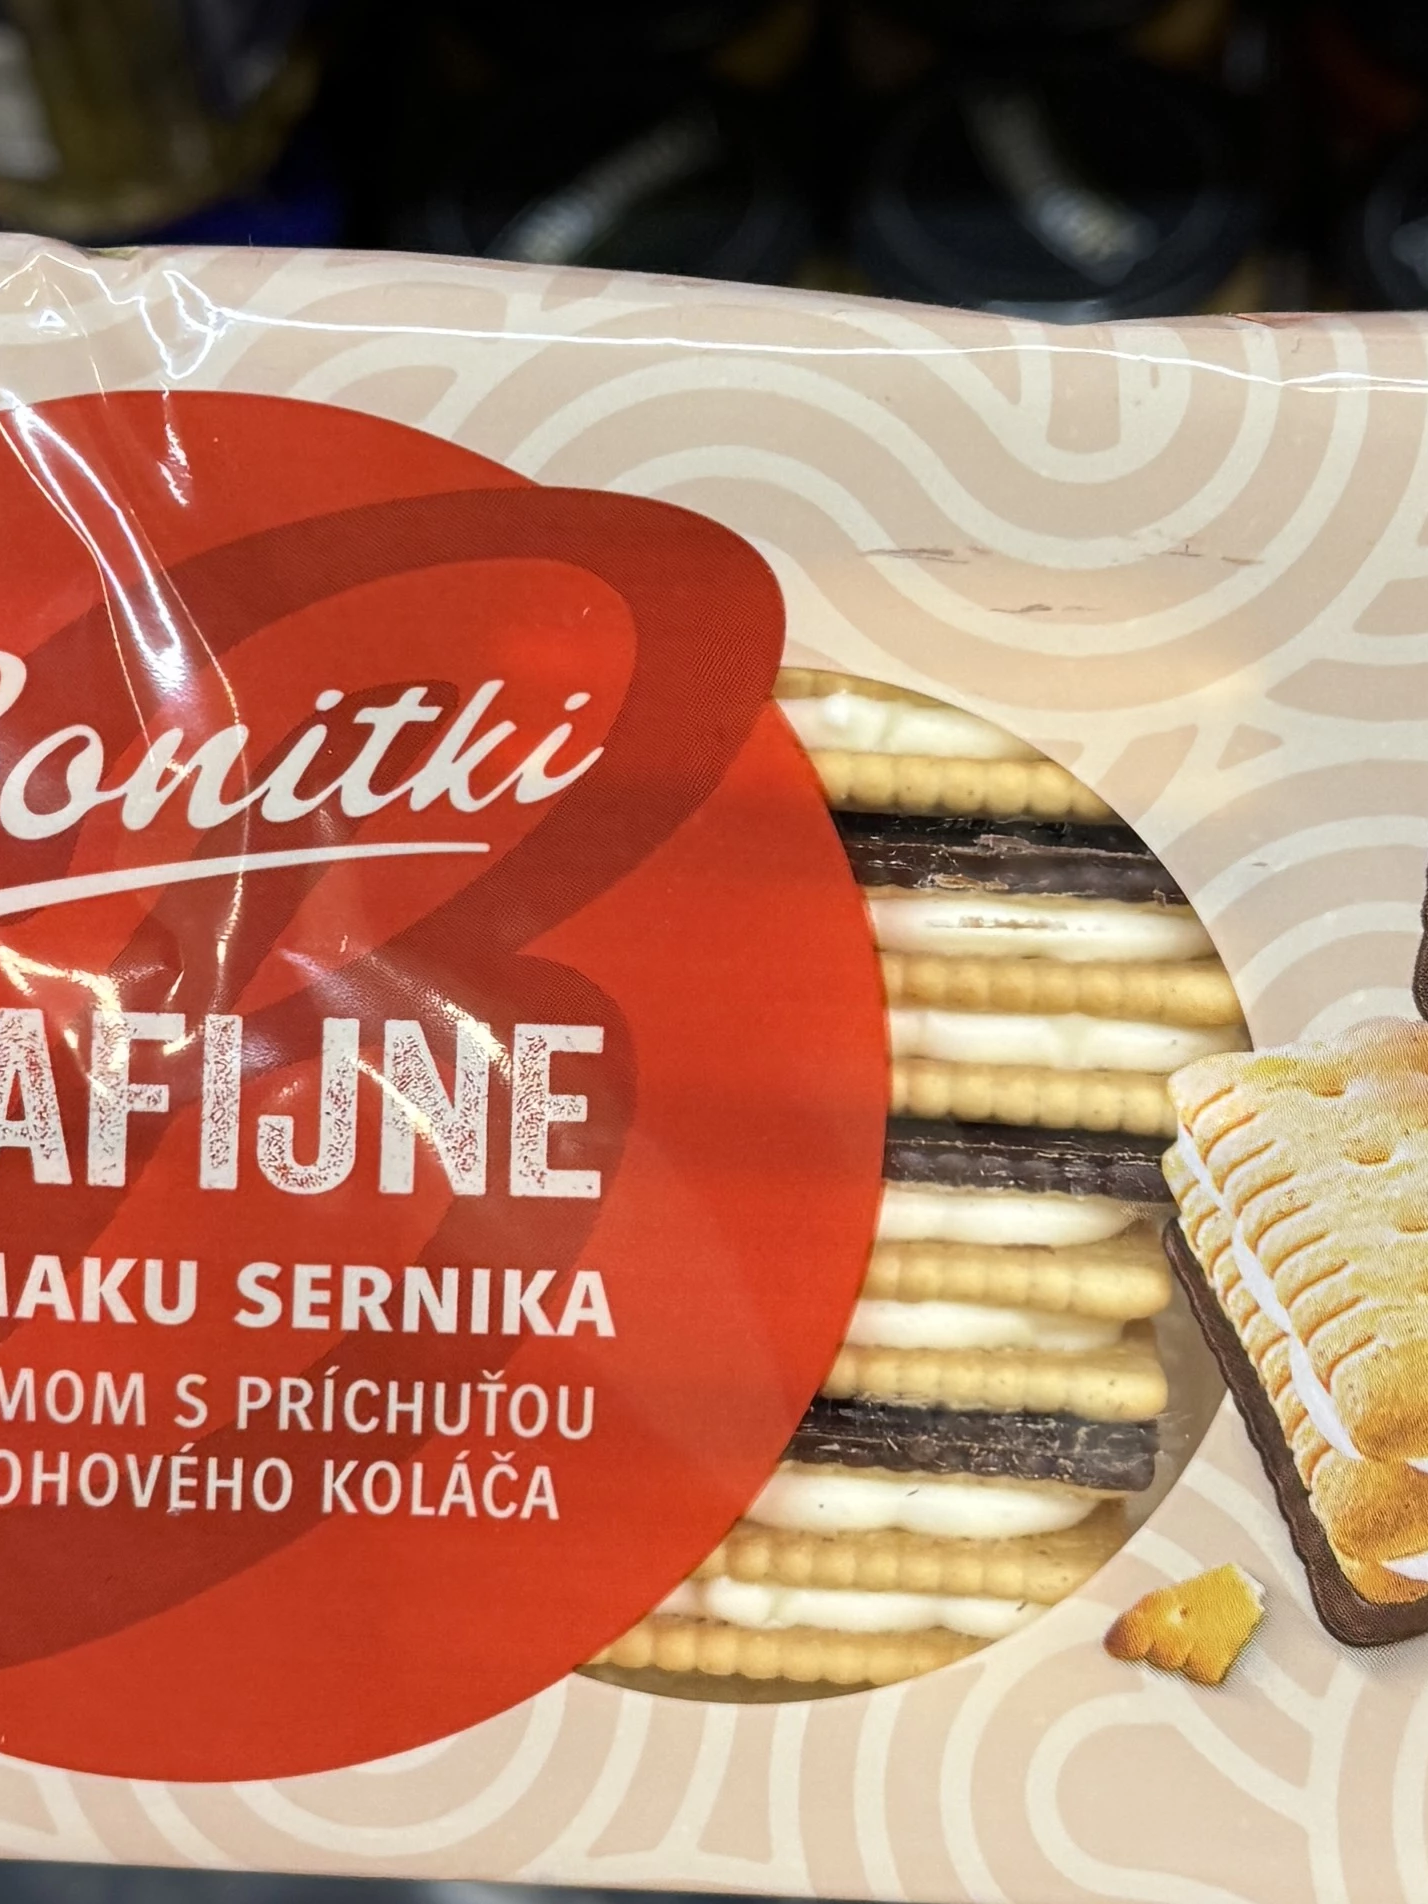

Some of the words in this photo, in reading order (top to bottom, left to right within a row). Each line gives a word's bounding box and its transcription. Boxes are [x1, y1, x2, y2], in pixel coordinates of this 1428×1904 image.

[235, 1261, 615, 1337] SERNIKA
[175, 1374, 207, 1429] S
[236, 1369, 595, 1440] PRÍCHUŤOU
[321, 1453, 559, 1520] KOLÁČA
